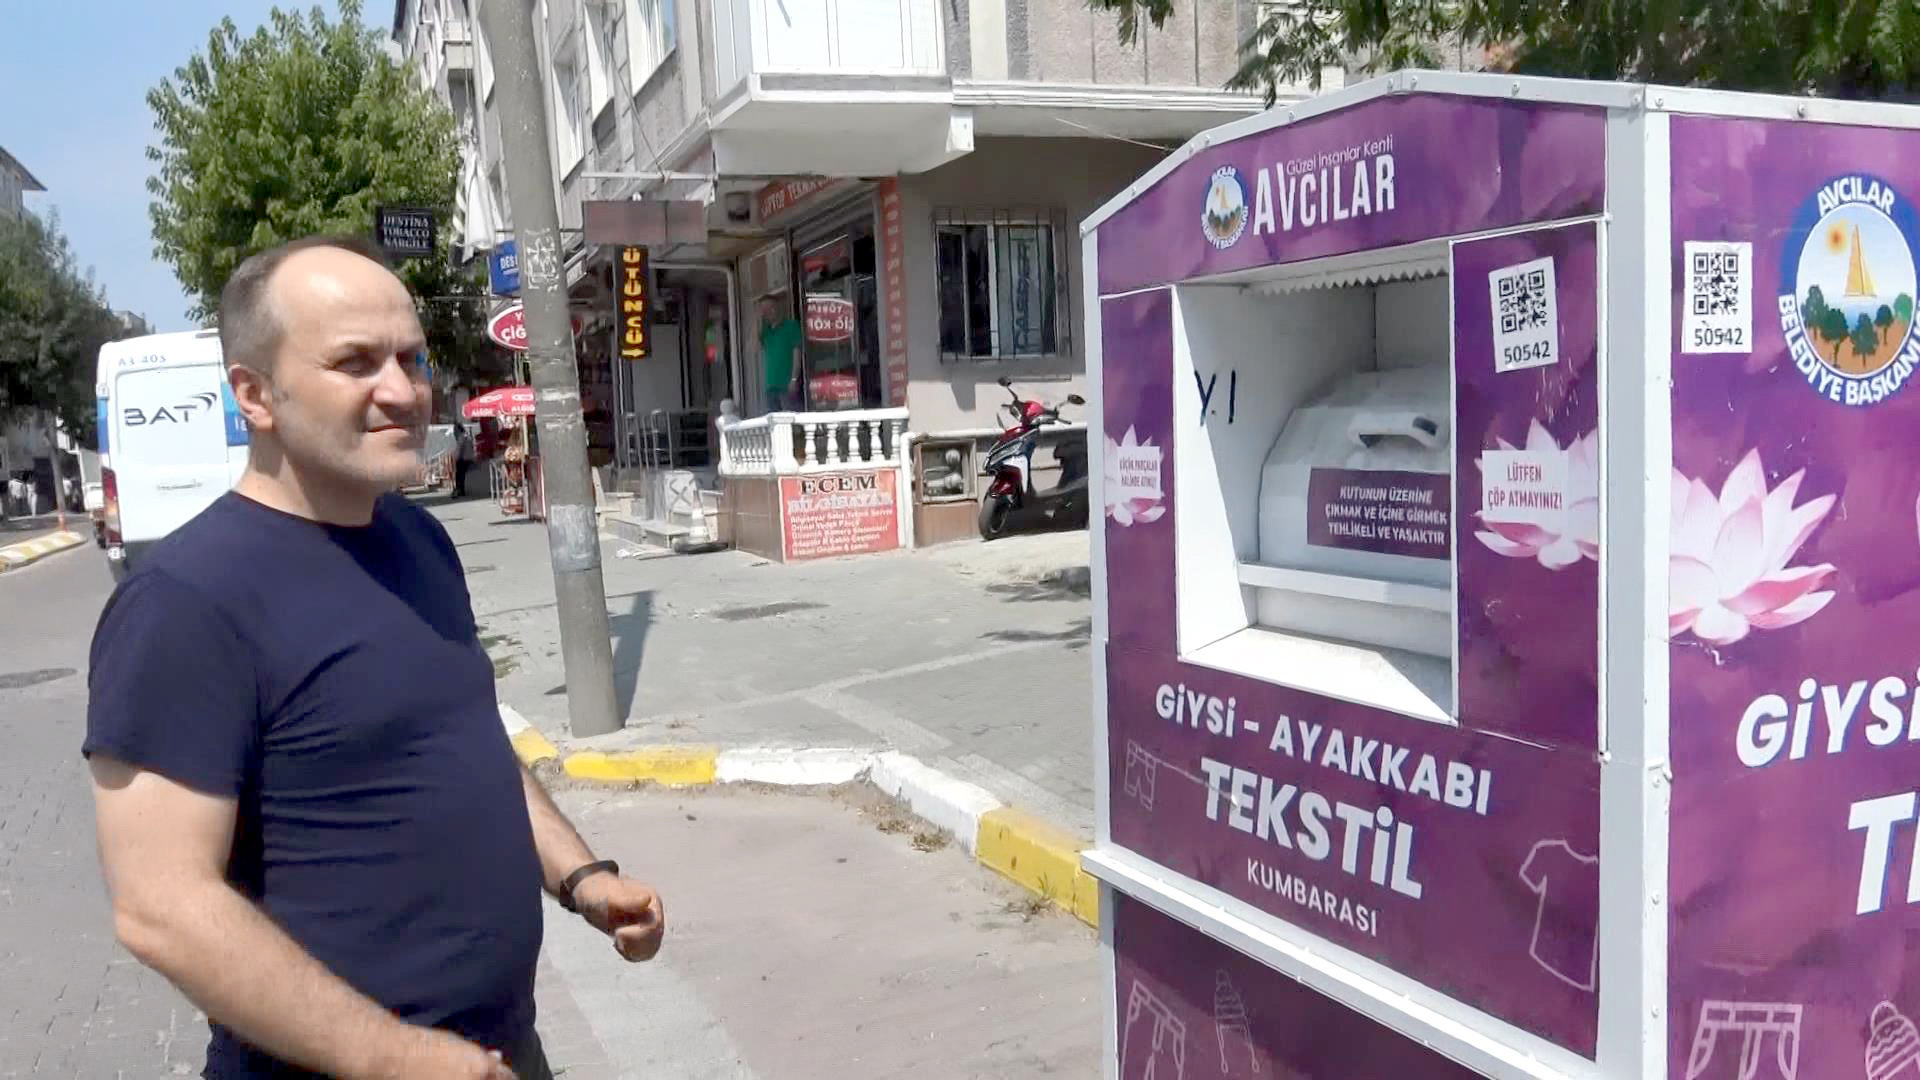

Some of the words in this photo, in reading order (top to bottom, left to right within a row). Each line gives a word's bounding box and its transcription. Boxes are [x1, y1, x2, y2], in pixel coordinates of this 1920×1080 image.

[1363, 134, 1393, 156] Kenti
[1253, 153, 1395, 236] AVCILAR
[1817, 176, 1895, 217] AVCILAR
[1504, 340, 1551, 365] 50542
[124, 405, 198, 427] BAT
[1507, 460, 1542, 482] LÜTFEN
[801, 476, 878, 495] ECEM
[1340, 486, 1387, 501] KUTUNUN
[1389, 486, 1434, 505] ÜZERİNE
[1488, 486, 1506, 508] ÇÖP
[1508, 490, 1562, 511] ATMAYINIZ!
[1325, 503, 1361, 519] ÇIKMAK
[1363, 506, 1377, 520] VE
[1378, 503, 1405, 522] İÇİNE
[1407, 507, 1447, 525] GİRMEK
[1328, 521, 1376, 538] TEHLİKELİ
[1378, 525, 1391, 540] VE
[1392, 527, 1446, 545] YASAKTIR
[1269, 714, 1491, 816] AYAKKABI
[1247, 857, 1377, 937] KUMBARASI
